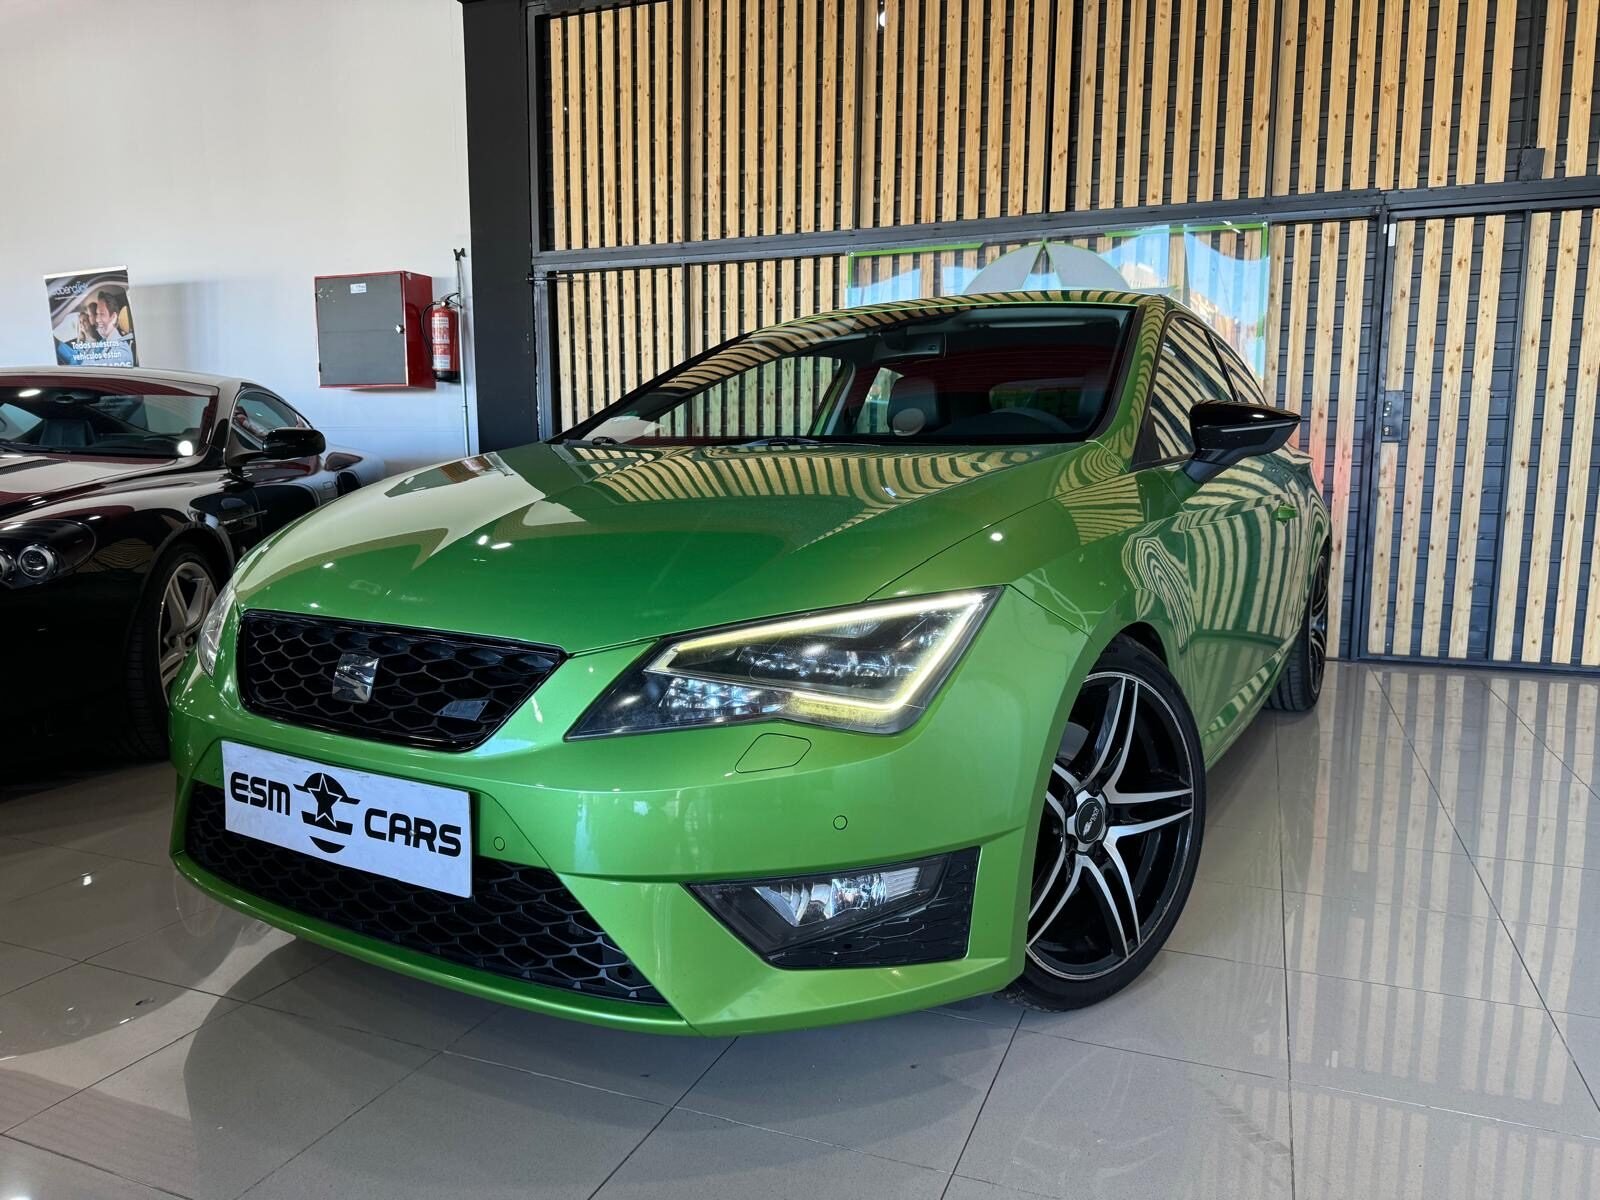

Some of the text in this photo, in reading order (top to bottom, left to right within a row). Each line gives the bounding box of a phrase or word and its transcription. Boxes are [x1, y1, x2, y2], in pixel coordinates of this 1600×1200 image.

[71, 340, 119, 349] Todos nuestros
[230, 771, 462, 857] ESM CARS
